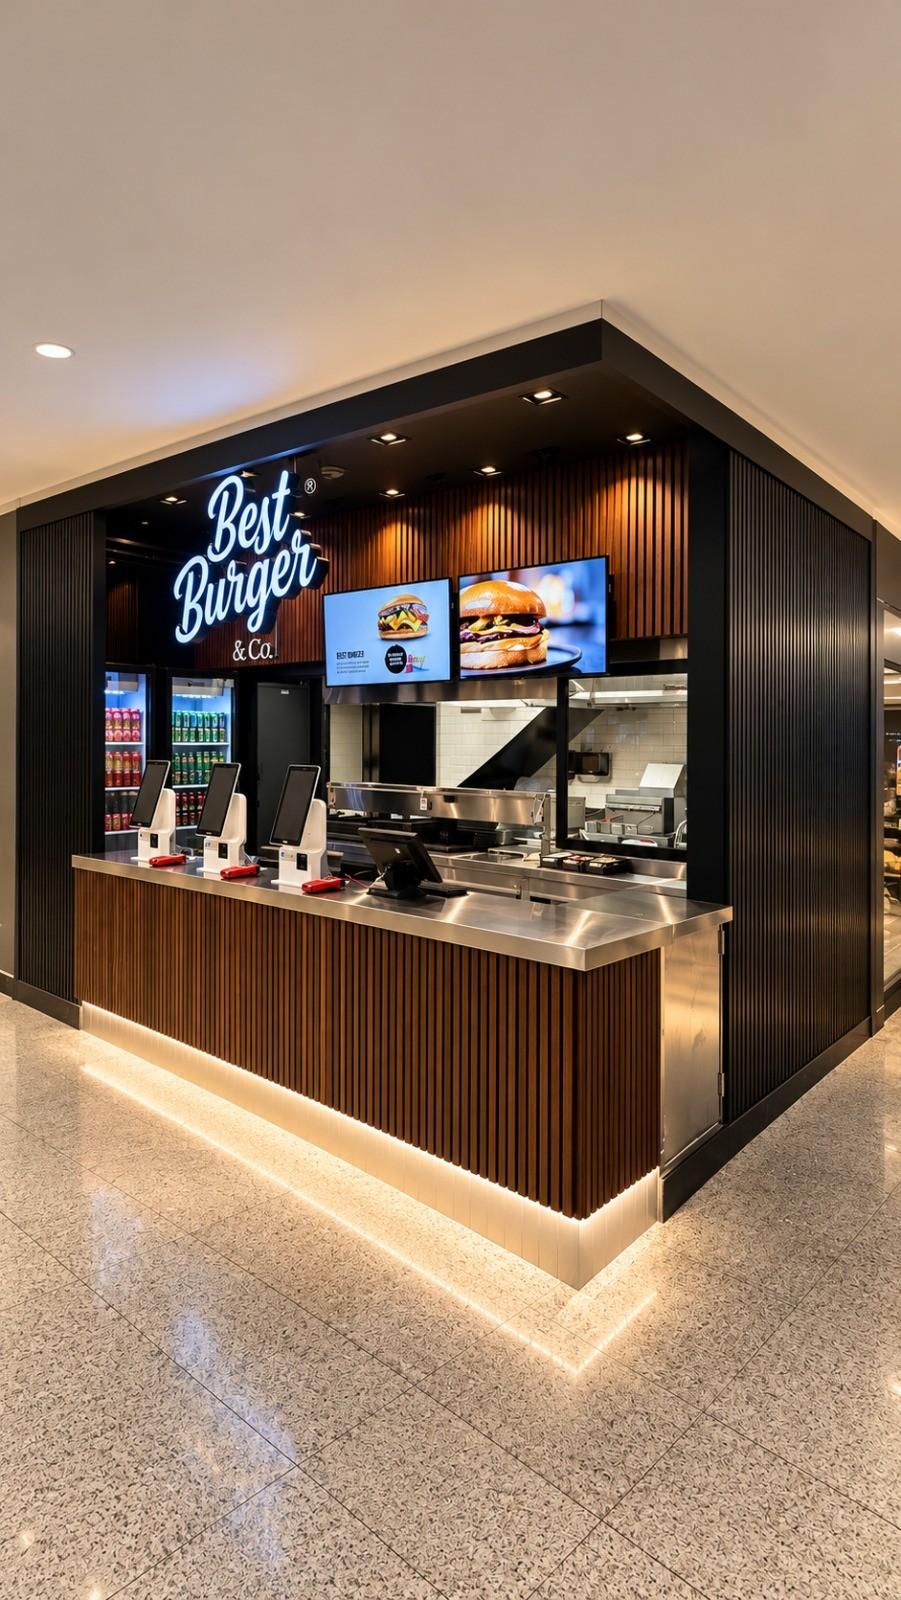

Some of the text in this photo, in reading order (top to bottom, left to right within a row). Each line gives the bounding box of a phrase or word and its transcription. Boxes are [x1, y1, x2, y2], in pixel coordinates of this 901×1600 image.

[207, 470, 291, 563] Best
[173, 529, 318, 644] Burger
[232, 638, 274, 661] & Co.
